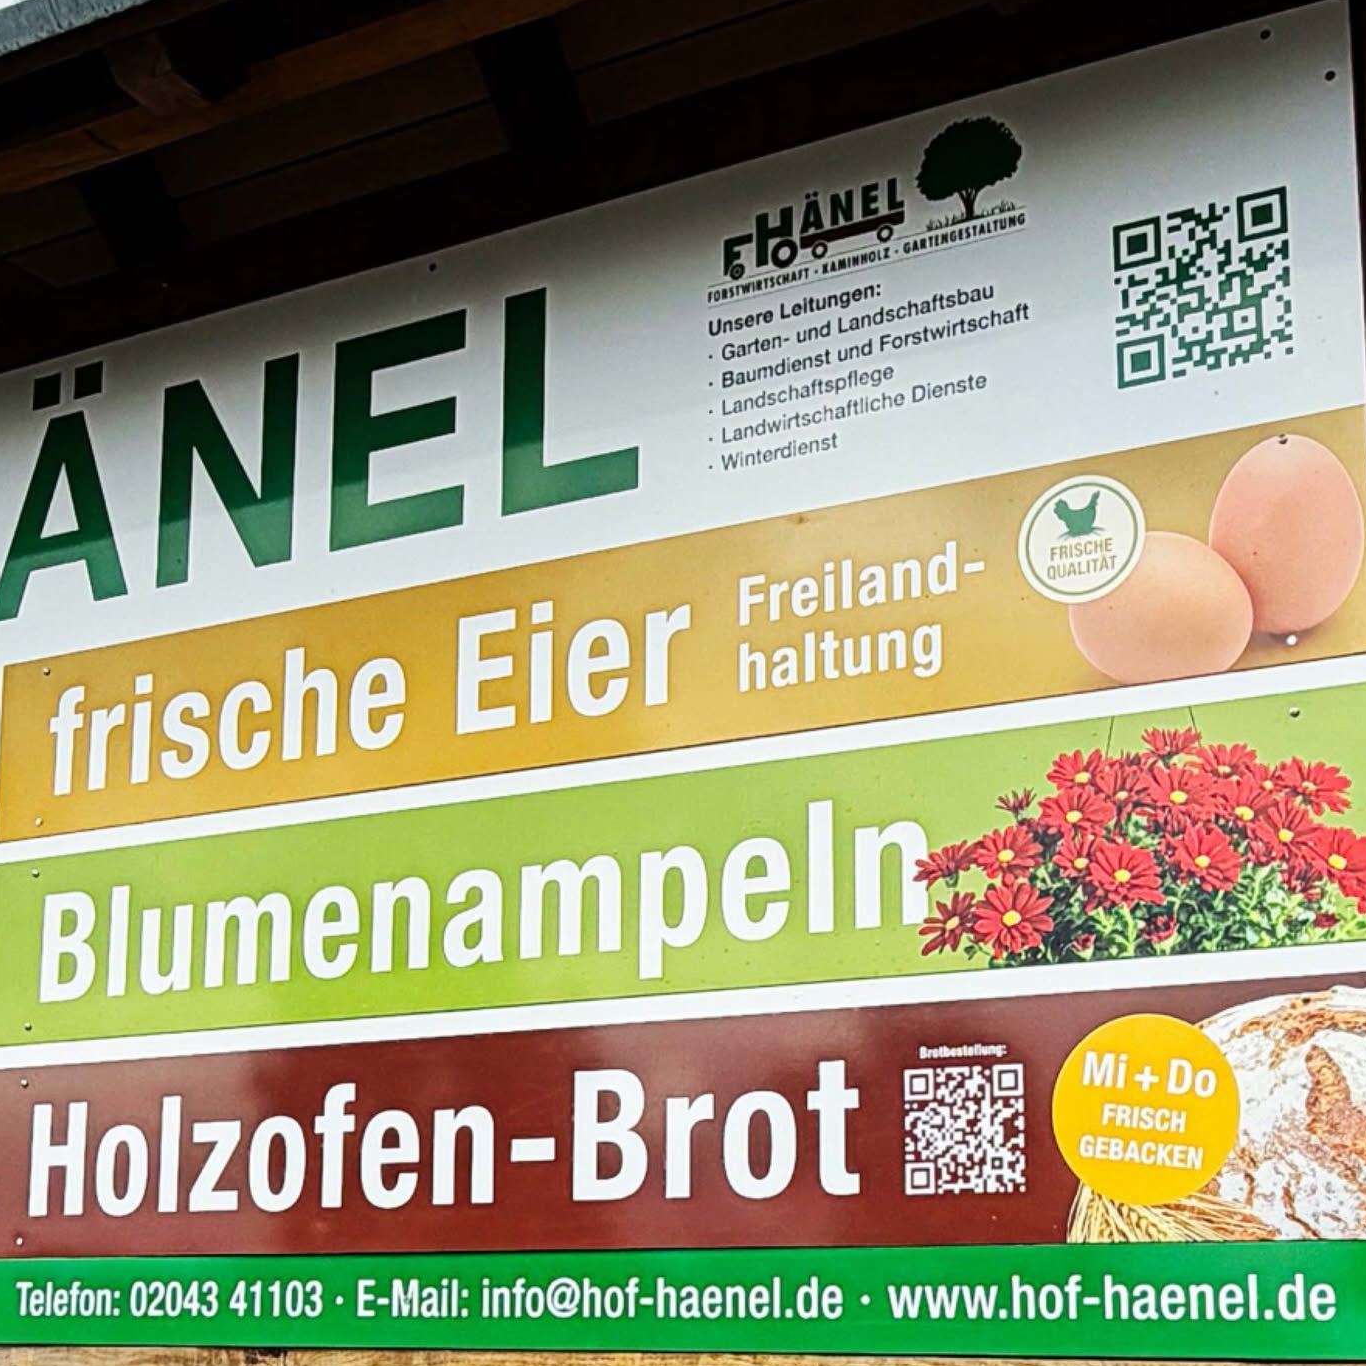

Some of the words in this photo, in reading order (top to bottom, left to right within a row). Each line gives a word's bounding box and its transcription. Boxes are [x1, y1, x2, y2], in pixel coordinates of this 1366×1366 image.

[707, 267, 810, 304] FORSTWIRTSCHAFT
[821, 246, 891, 275] KAMINHOLZ
[903, 212, 1027, 255] GARTENGESTALTUNG
[708, 309, 774, 337] Unsere
[780, 283, 882, 319] Leitungen:
[721, 335, 791, 361] Garten-
[796, 320, 832, 344] und
[837, 284, 995, 334] Landschaftsbau
[721, 348, 832, 389] Baumdienst
[837, 338, 873, 363] und
[879, 302, 1030, 352] Forstwirtschaft
[721, 365, 895, 416] Landschaftspflege
[721, 391, 906, 444] Landwirtschaftliche
[911, 373, 988, 403] Dienste
[721, 432, 839, 471] Winterdienst
[1046, 554, 1118, 580] QUALITÄT
[1049, 537, 1113, 562] FRISCHE
[737, 540, 987, 628] Freiland-
[737, 623, 944, 693] haltung
[49, 645, 407, 797] frische
[455, 599, 692, 738] Eier
[38, 800, 930, 1003] Blumenampeln
[1081, 1049, 1126, 1090] Mi
[1166, 1058, 1217, 1098] Do
[27, 1058, 861, 1218] Holzofen-Brot
[1101, 1103, 1187, 1134] FRISCH
[1079, 1134, 1204, 1171] GEBACKEN
[16, 1280, 121, 1319] Telefon:
[129, 1280, 219, 1319] 02043
[228, 1280, 323, 1319] 41103
[356, 1278, 470, 1320] E-Mail:
[480, 1275, 843, 1321] info@hof-haenel.de
[887, 1272, 1337, 1322] www.hof-haenel.de
